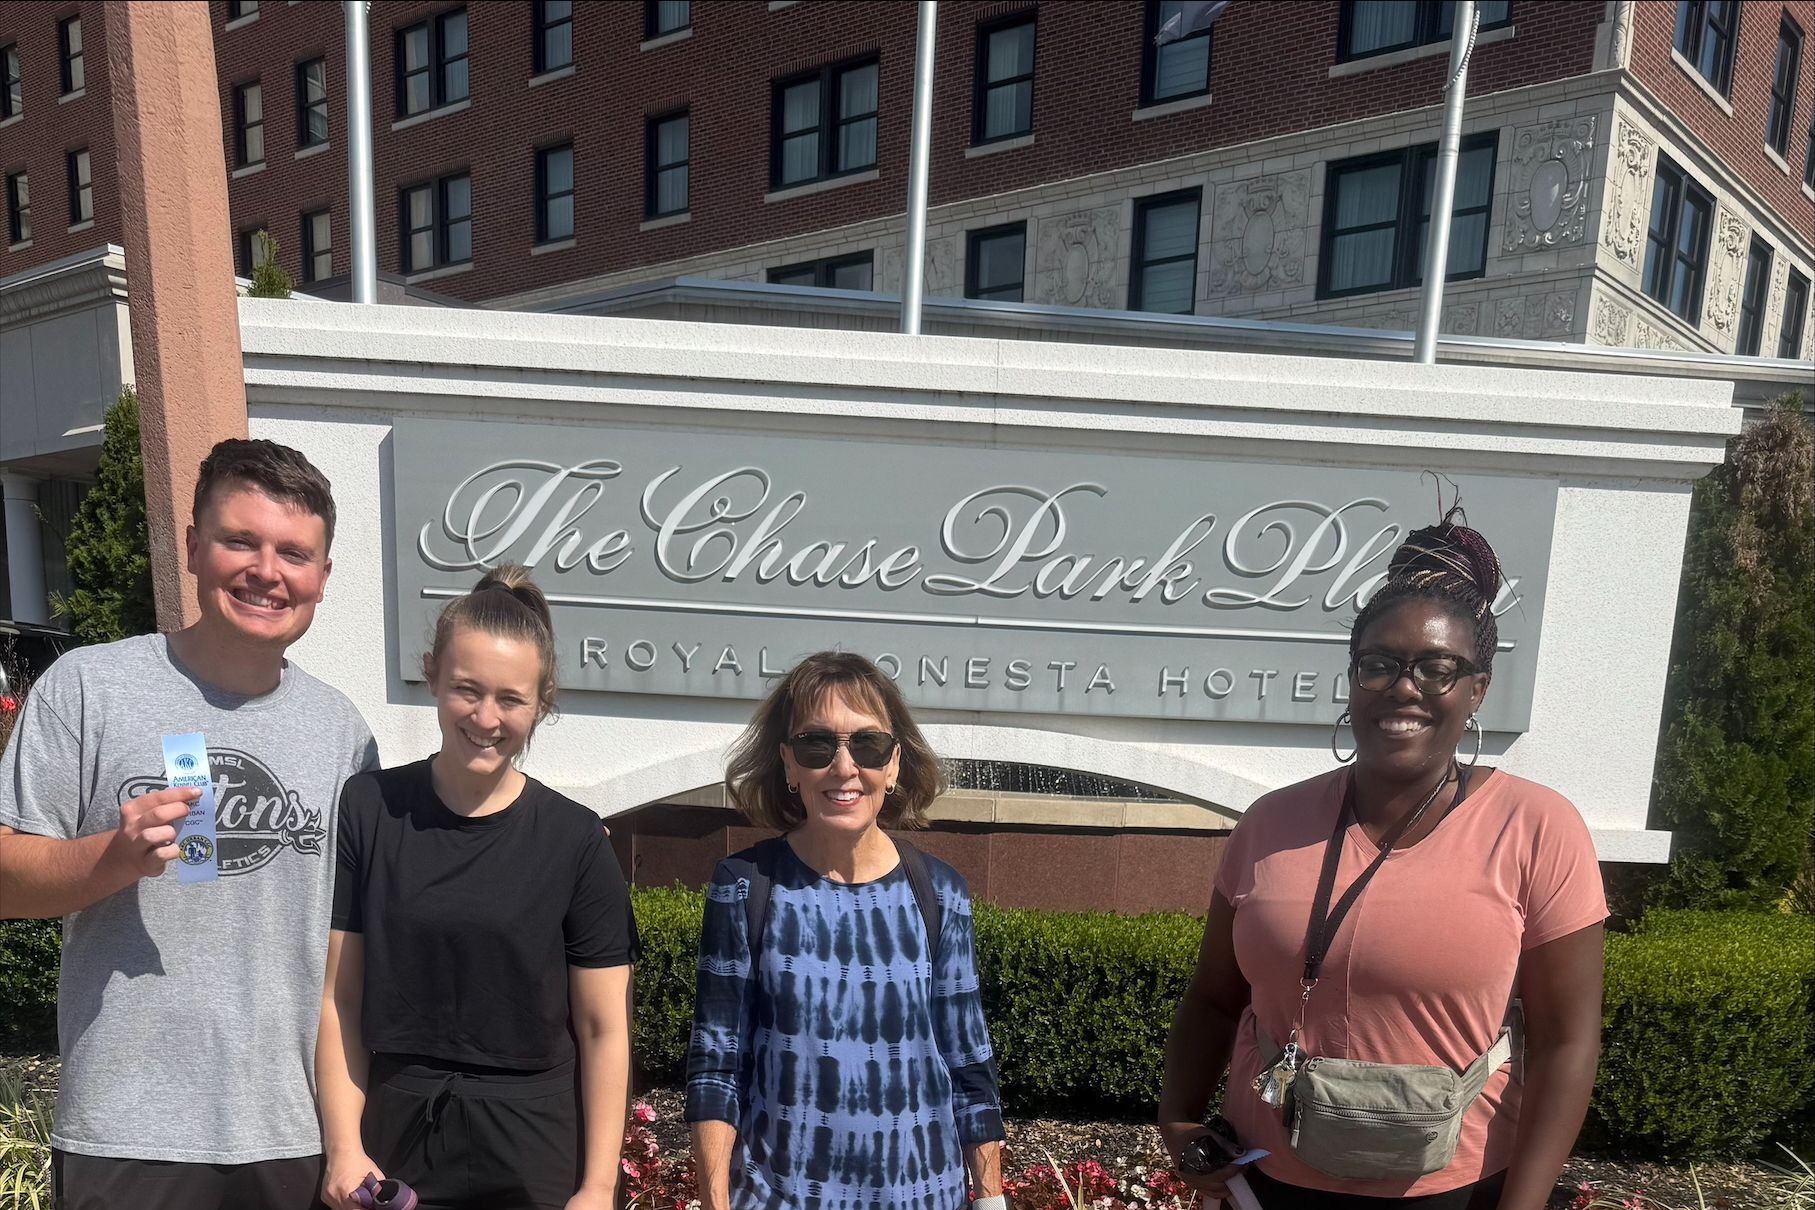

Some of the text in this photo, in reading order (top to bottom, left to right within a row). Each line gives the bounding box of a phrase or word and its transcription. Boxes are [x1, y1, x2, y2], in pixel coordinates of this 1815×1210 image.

[418, 459, 634, 574] The
[641, 464, 922, 589] Chase
[924, 482, 1202, 603] Park
[580, 637, 1349, 703] ROYAL ONESTA HOTEL
[208, 756, 245, 770] MSL
